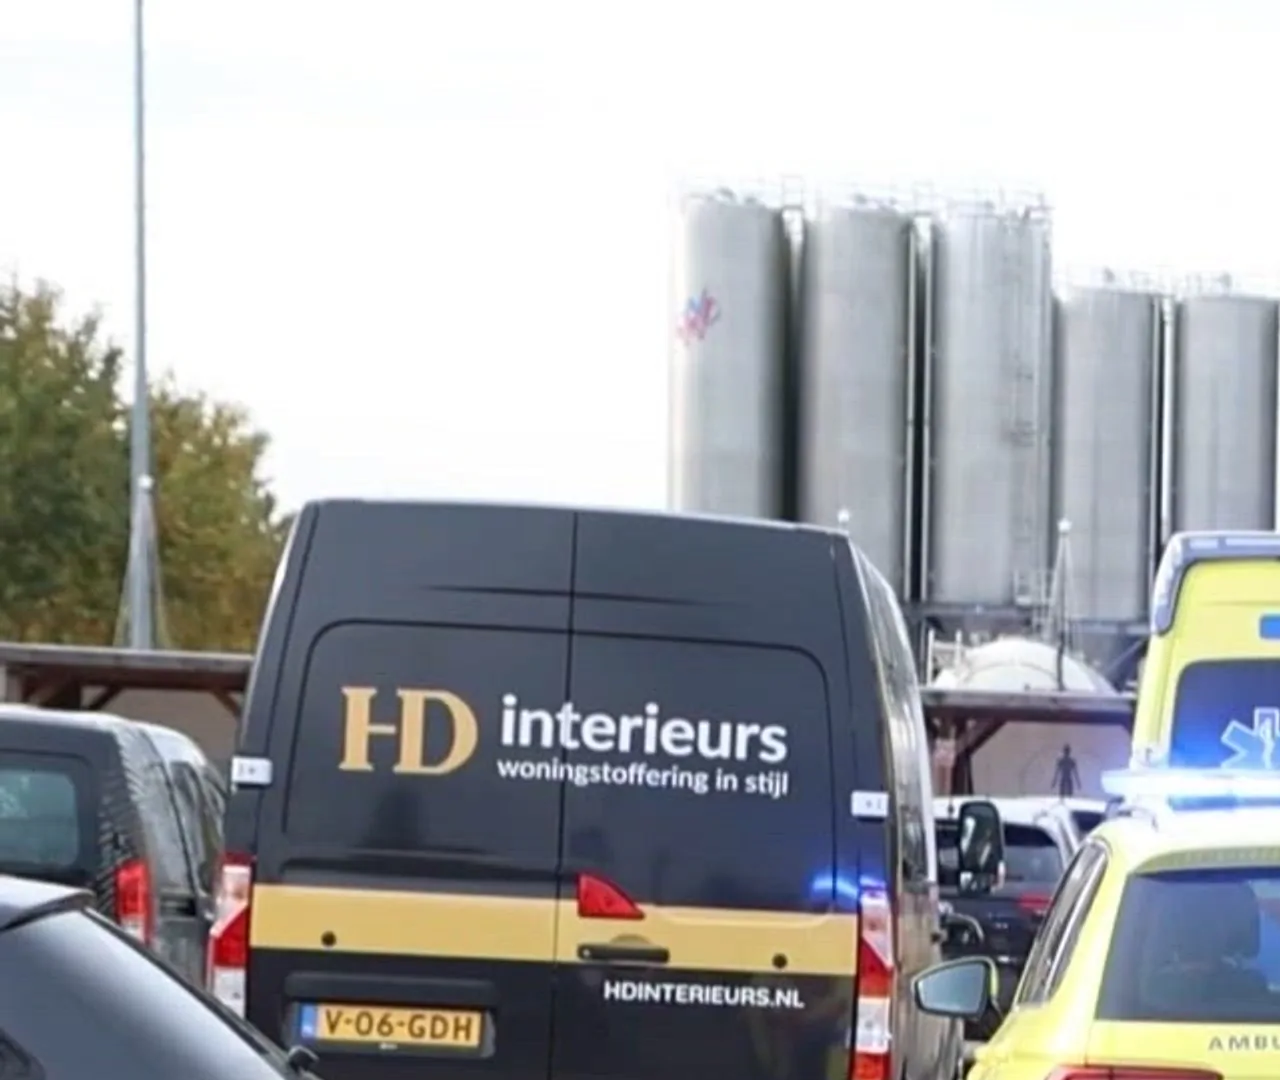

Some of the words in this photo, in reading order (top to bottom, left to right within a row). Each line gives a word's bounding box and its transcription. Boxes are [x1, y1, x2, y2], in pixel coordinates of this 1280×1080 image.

[338, 686, 479, 776] HD
[501, 694, 789, 763] interieurs
[498, 757, 709, 795] woningstoffering
[715, 768, 739, 792] in
[745, 770, 789, 799] stijl
[603, 980, 806, 1008] HDINTERIEURS.NL
[323, 1008, 474, 1043] V-06-GDH
